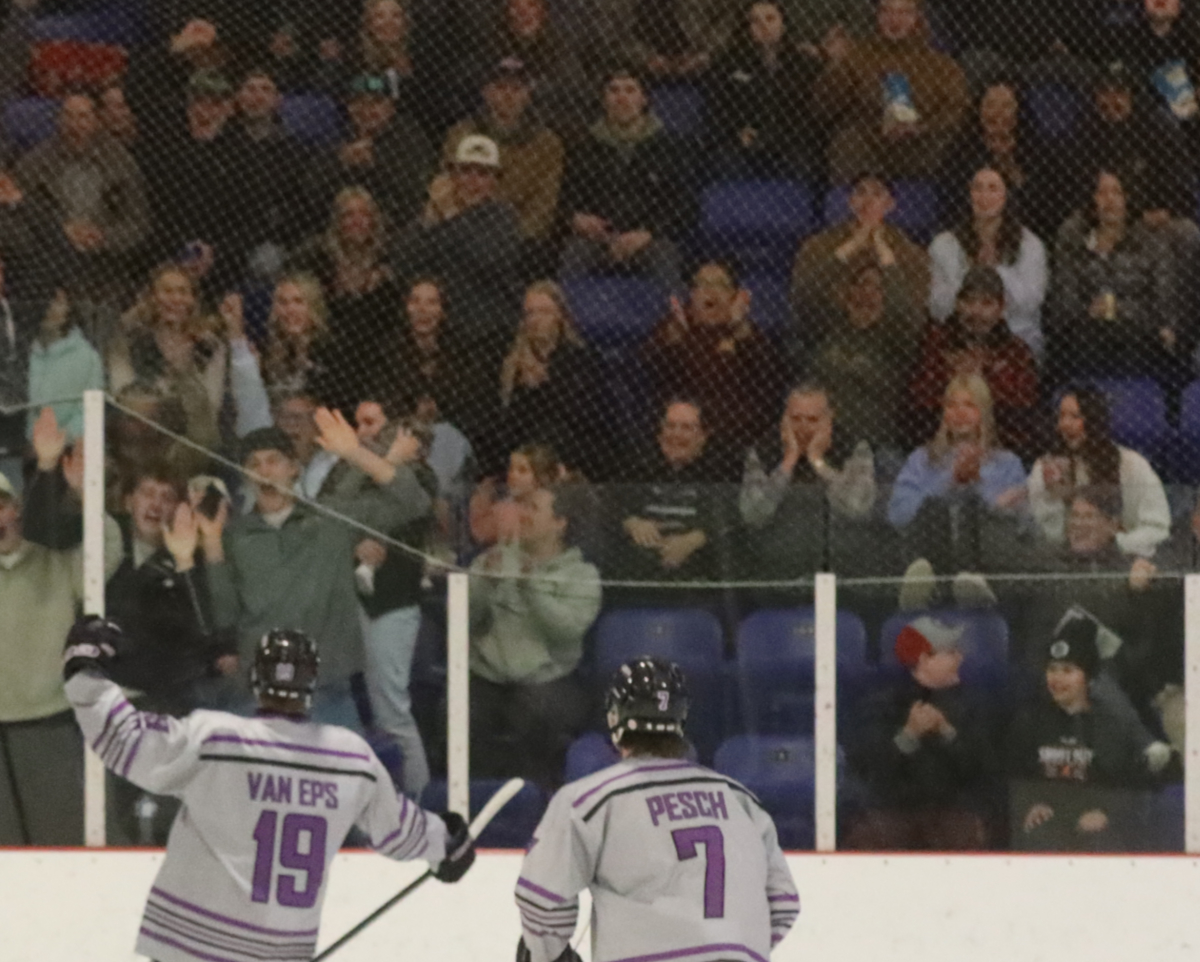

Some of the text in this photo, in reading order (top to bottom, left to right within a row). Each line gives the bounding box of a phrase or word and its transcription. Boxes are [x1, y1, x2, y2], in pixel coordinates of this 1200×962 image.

[657, 690, 670, 711] 7
[247, 771, 339, 809] VAN EPS
[645, 790, 729, 827] PESCH
[251, 809, 328, 909] 19
[670, 825, 726, 919] 7
